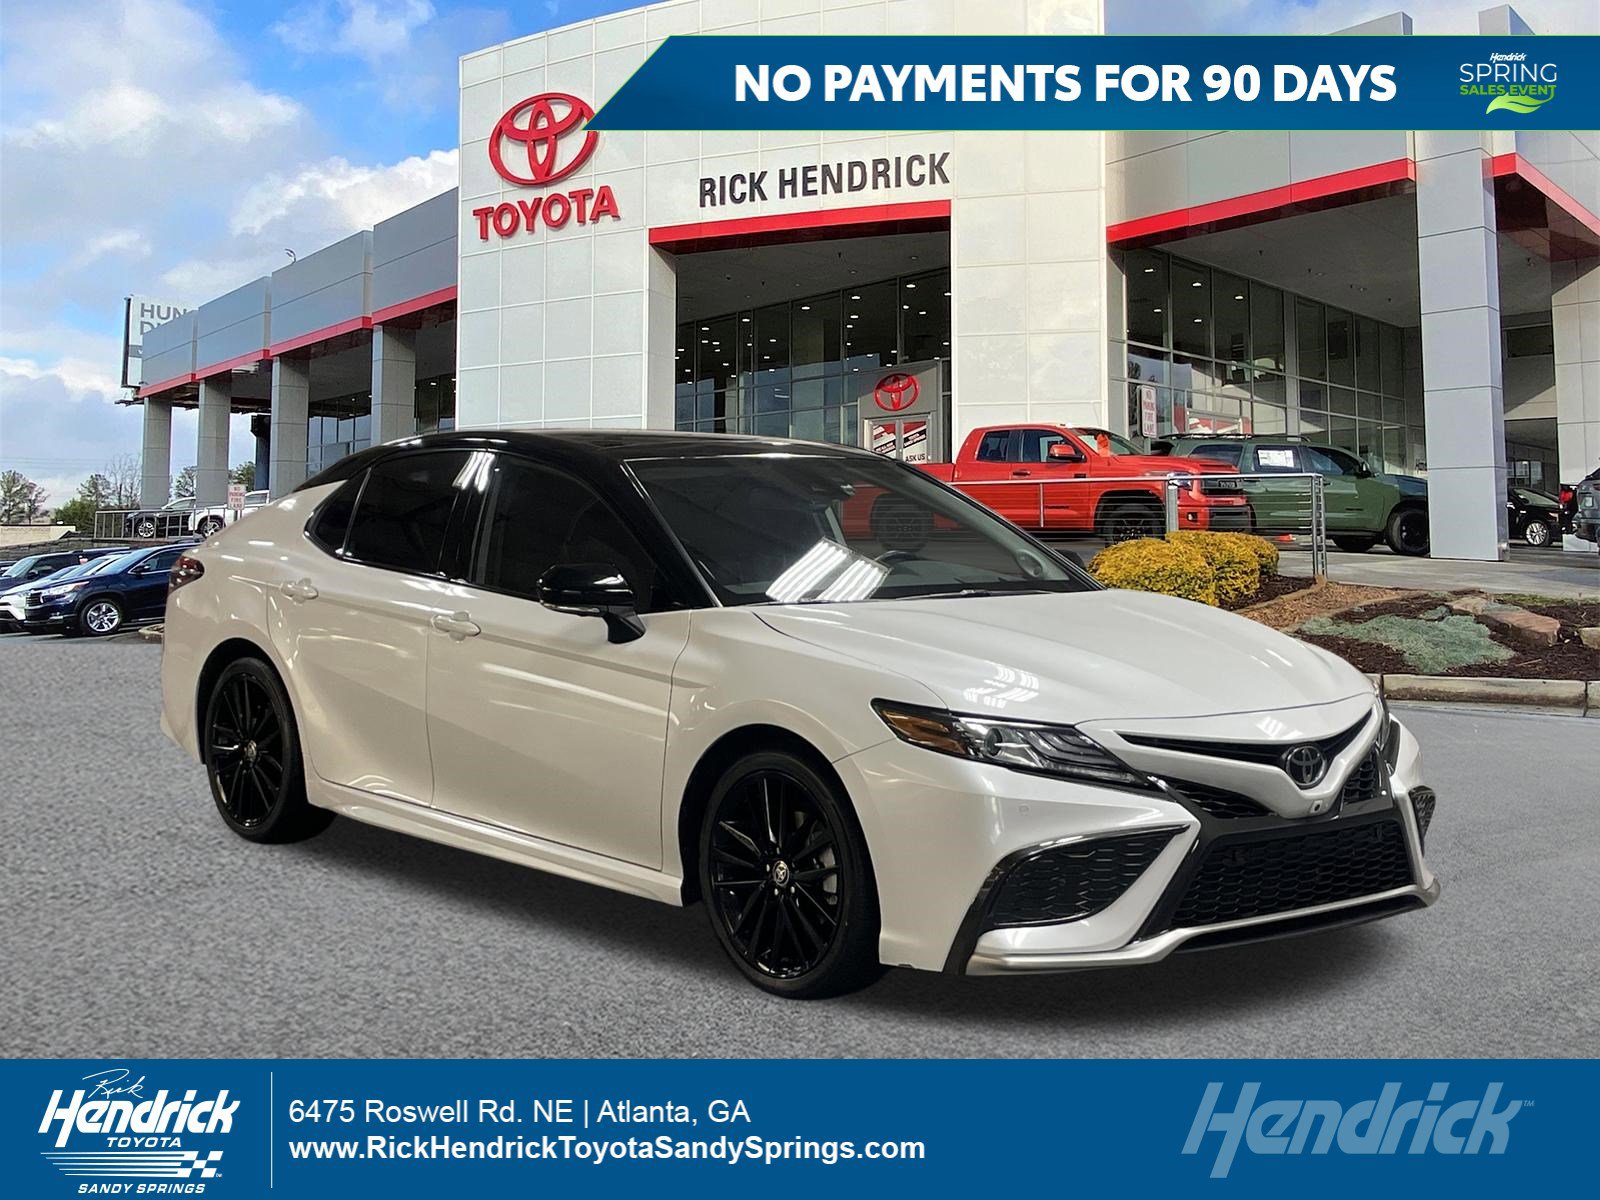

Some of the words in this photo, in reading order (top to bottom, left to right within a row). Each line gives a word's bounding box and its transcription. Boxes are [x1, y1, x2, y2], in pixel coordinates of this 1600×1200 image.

[699, 170, 768, 208] RICK
[779, 152, 950, 199] HENDRICK
[473, 184, 620, 240] TOYOTA
